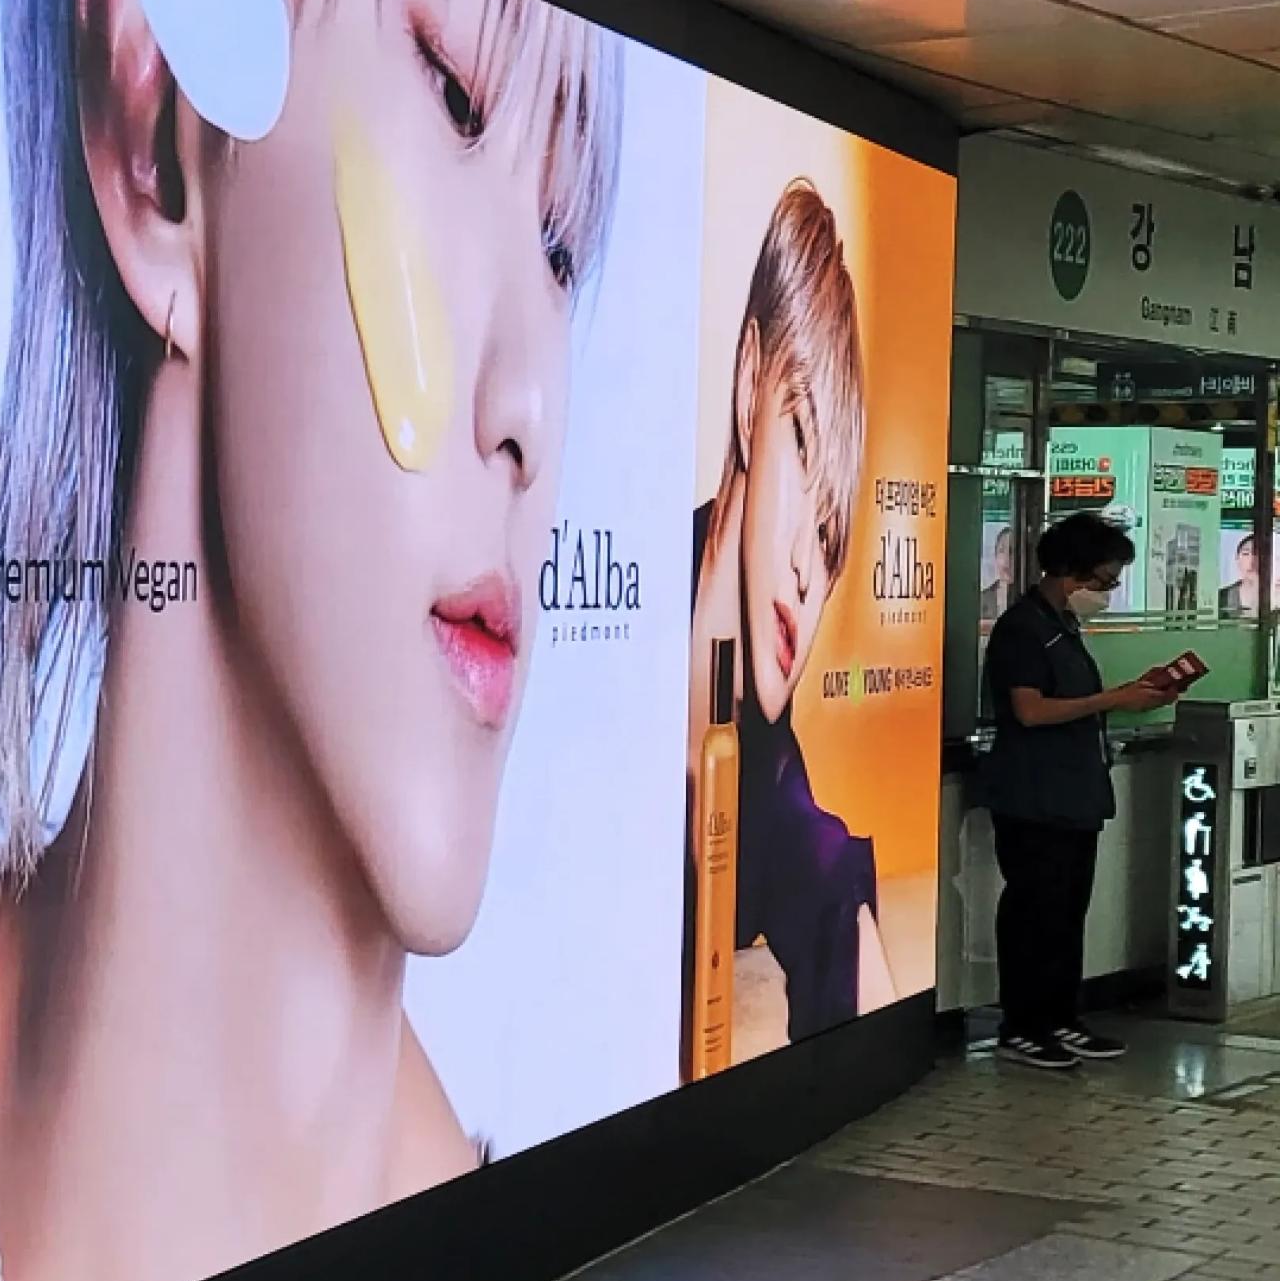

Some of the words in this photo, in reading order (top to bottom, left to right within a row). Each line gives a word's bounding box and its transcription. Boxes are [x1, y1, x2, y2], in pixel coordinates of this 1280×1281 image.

[1052, 222, 1087, 265] 222
[118, 546, 199, 614] Vegan
[538, 519, 641, 611] d'Alba
[873, 528, 935, 601] d'Alba
